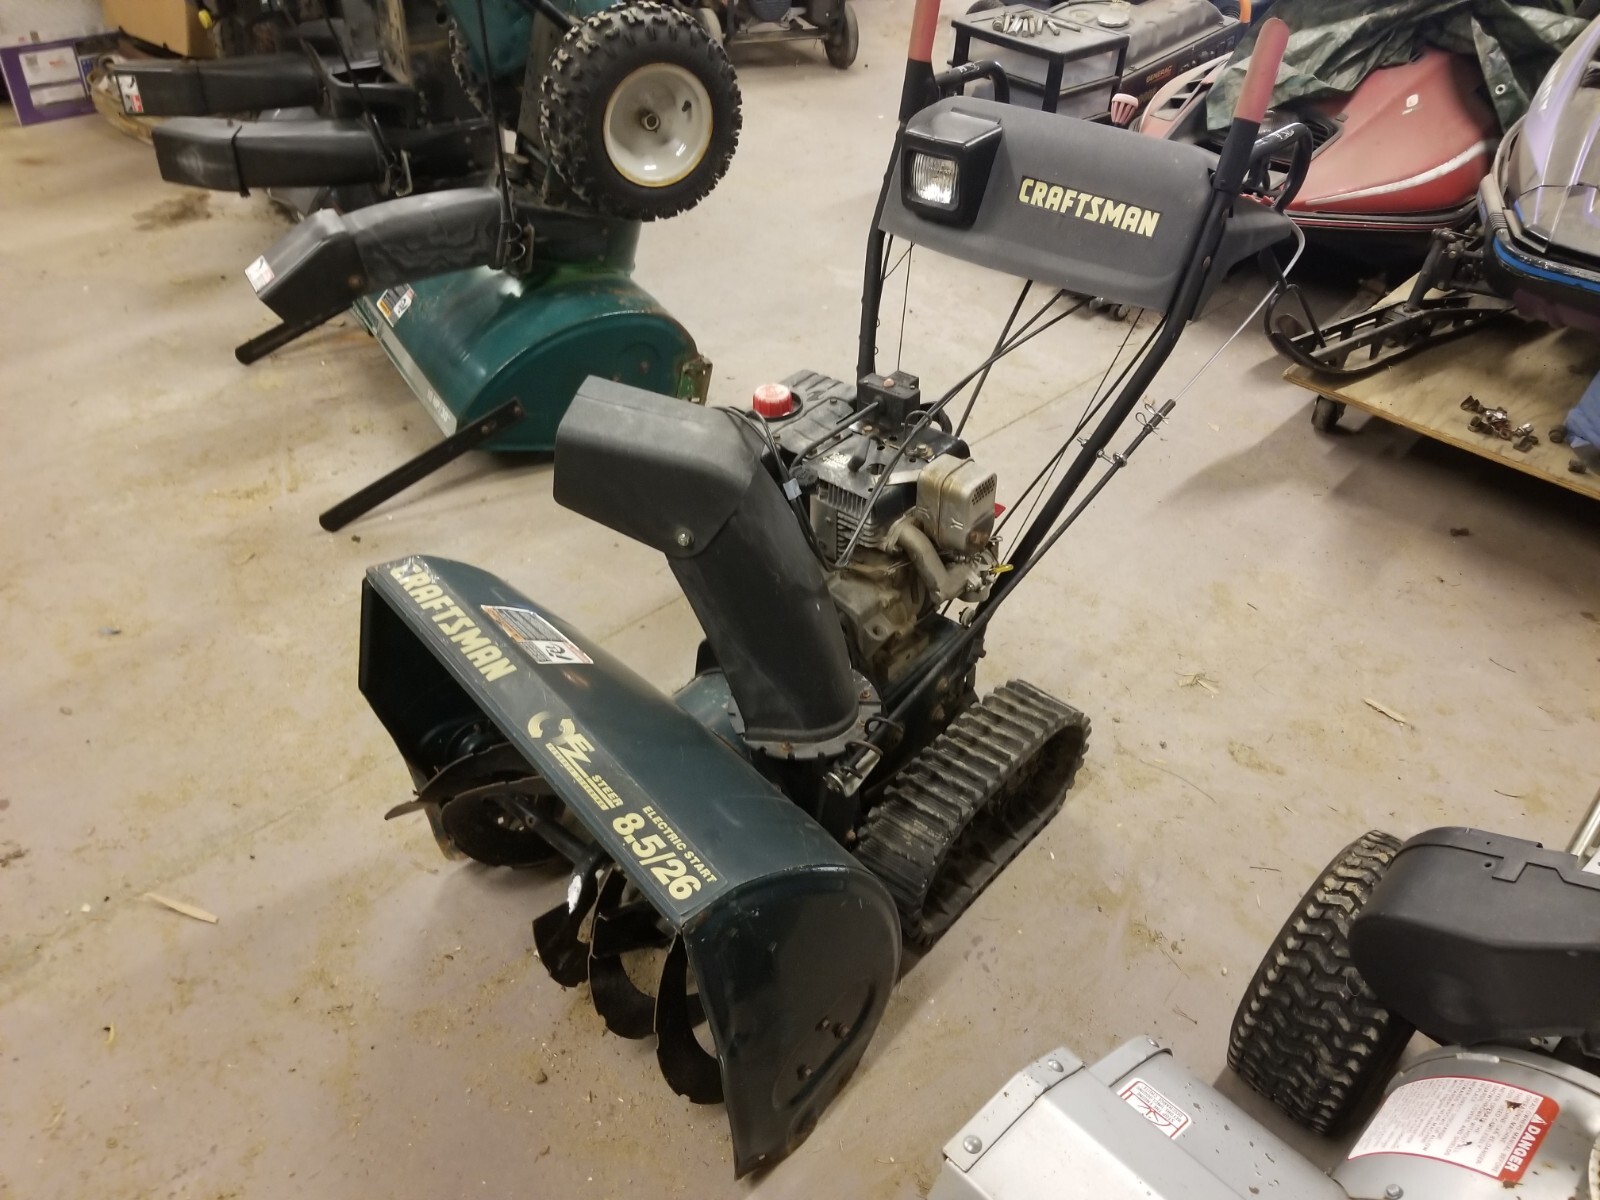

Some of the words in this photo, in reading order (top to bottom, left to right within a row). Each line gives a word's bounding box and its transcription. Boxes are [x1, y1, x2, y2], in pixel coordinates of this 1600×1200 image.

[1018, 178, 1160, 237] CRAFTSMAN
[390, 562, 517, 682] CRAFTSMAN
[592, 774, 624, 807] STEER
[612, 812, 702, 900] 8.5/26
[642, 805, 687, 850] ELECTRIC
[684, 850, 717, 883] START
[1504, 1127, 1542, 1172] DANGER
